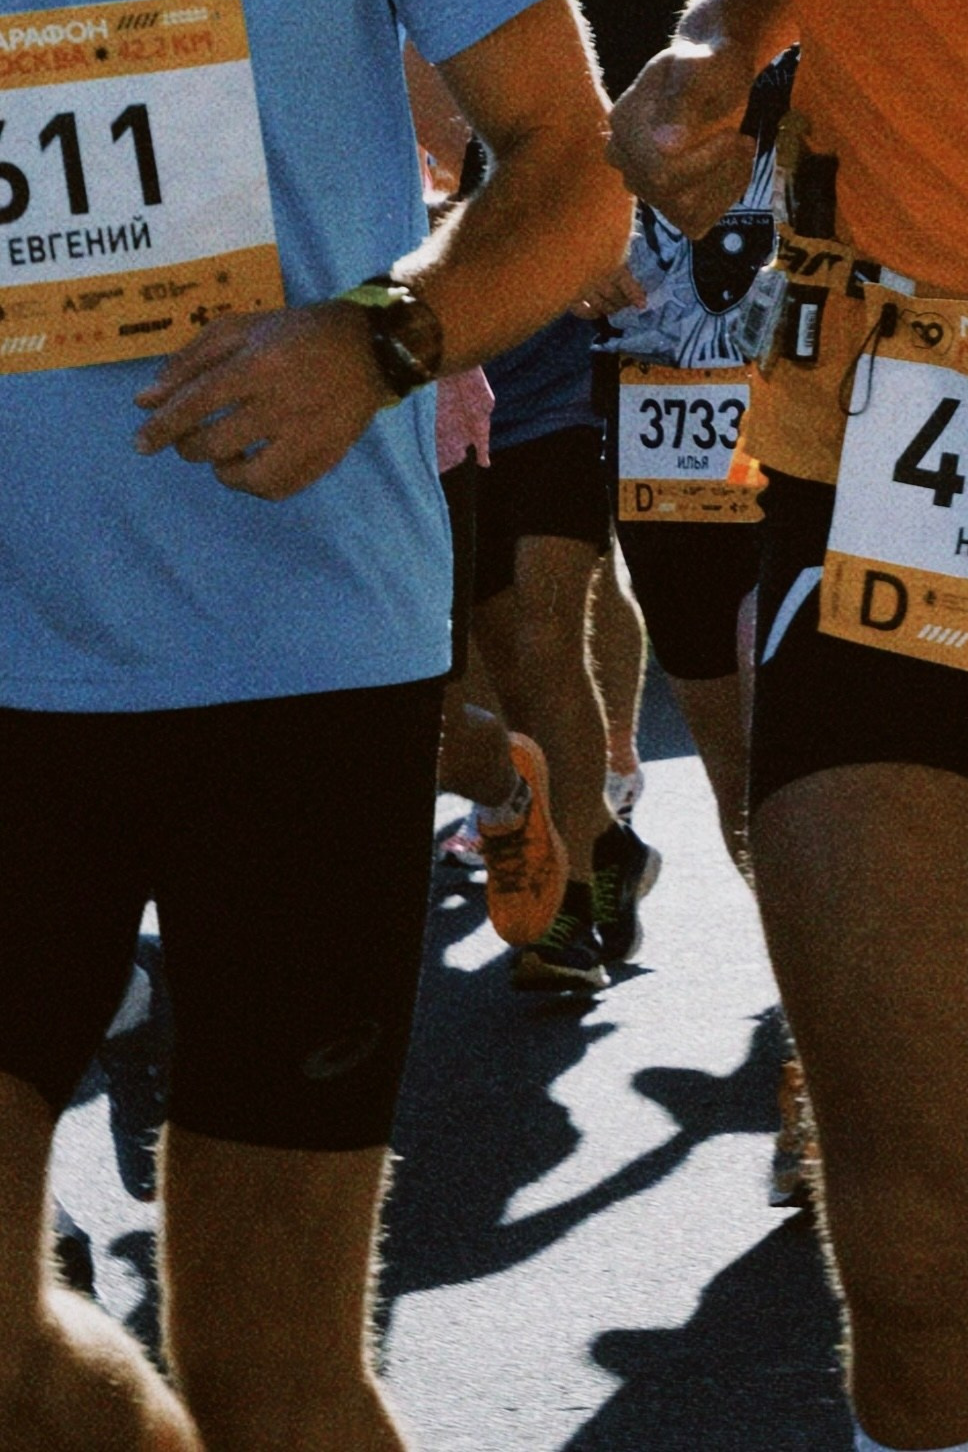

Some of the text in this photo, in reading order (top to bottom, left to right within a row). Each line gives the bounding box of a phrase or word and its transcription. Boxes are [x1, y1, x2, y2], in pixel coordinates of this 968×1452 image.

[10, 215, 152, 267] ЕВГЕНИЙ
[640, 398, 746, 449] 3733
[677, 455, 709, 469] ИЛЬЯ
[635, 483, 653, 512] D
[860, 570, 908, 632] D
